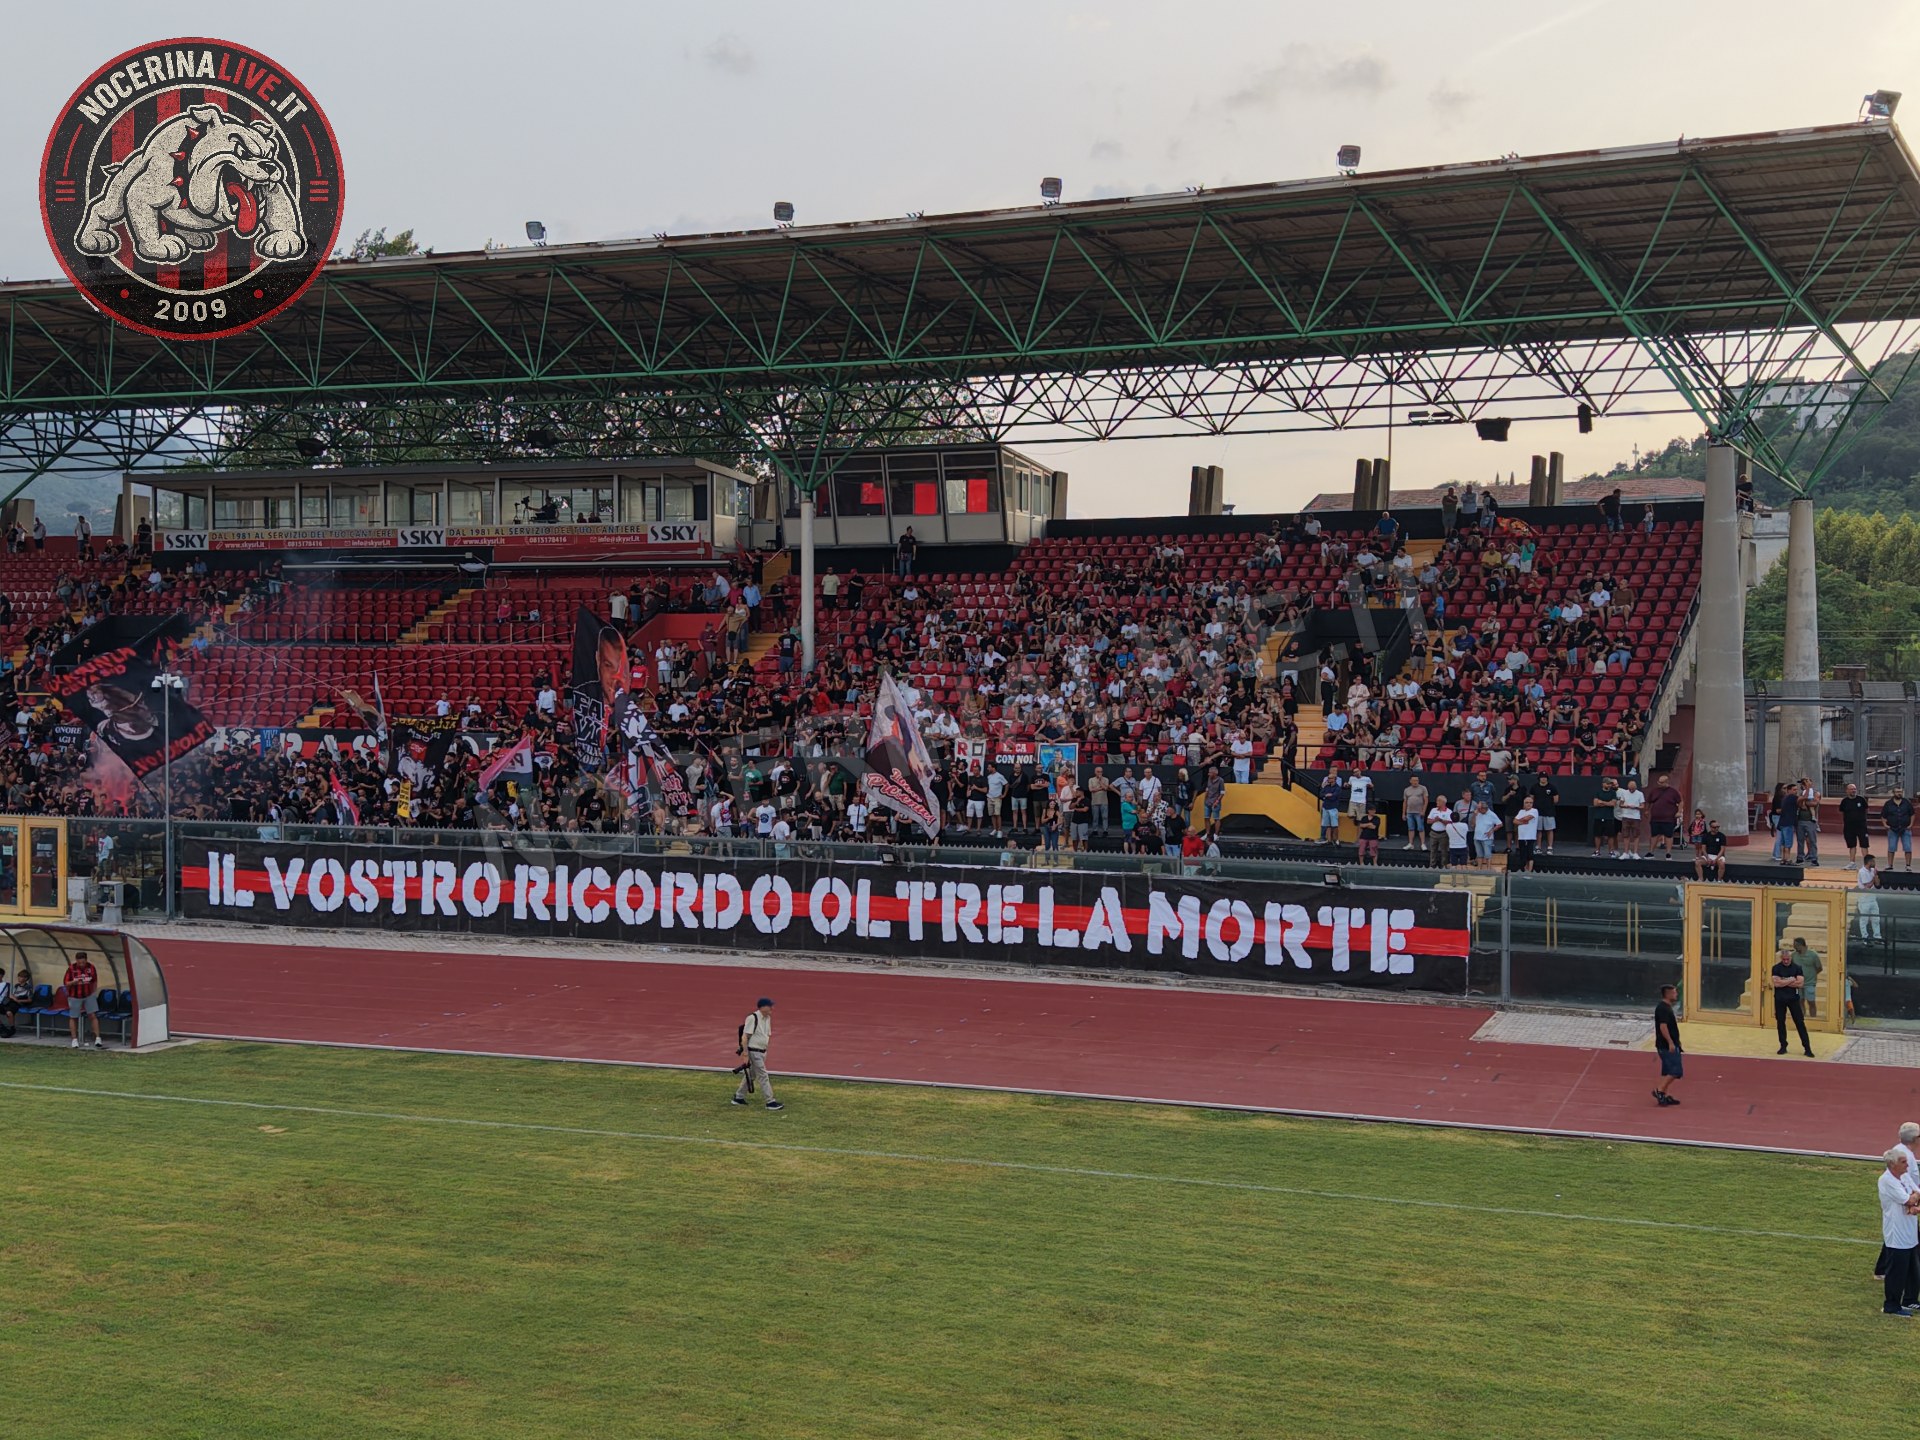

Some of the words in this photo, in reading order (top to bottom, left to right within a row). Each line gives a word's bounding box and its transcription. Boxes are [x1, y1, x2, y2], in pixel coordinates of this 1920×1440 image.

[211, 532, 227, 540] DAL
[231, 531, 251, 540] 1981
[254, 531, 265, 540] AL
[267, 530, 307, 539] SERVIZIO
[310, 529, 325, 538] DEL
[329, 529, 346, 538] TUO
[449, 528, 466, 537] DAL
[470, 528, 490, 536] 1981
[494, 527, 504, 536] AL
[508, 527, 551, 536] SERVIZIO
[554, 526, 570, 535] DEL
[574, 526, 592, 535] TUO
[661, 525, 697, 541] SKY
[175, 534, 207, 549] SKY
[410, 530, 444, 545] SKY
[462, 537, 505, 546] www.skysrl.it
[597, 535, 640, 544] info@skysrl.it
[54, 725, 83, 735] ONORE
[1002, 743, 1027, 753] LCA
[995, 753, 1015, 764] CON
[1015, 754, 1033, 765] NOI
[208, 851, 255, 907] IL
[263, 857, 501, 918] VOSTRO
[513, 864, 793, 936] RICORDO
[809, 877, 1024, 945] OLTRE
[1037, 886, 1132, 952] LA
[1147, 890, 1415, 975] MORTE
